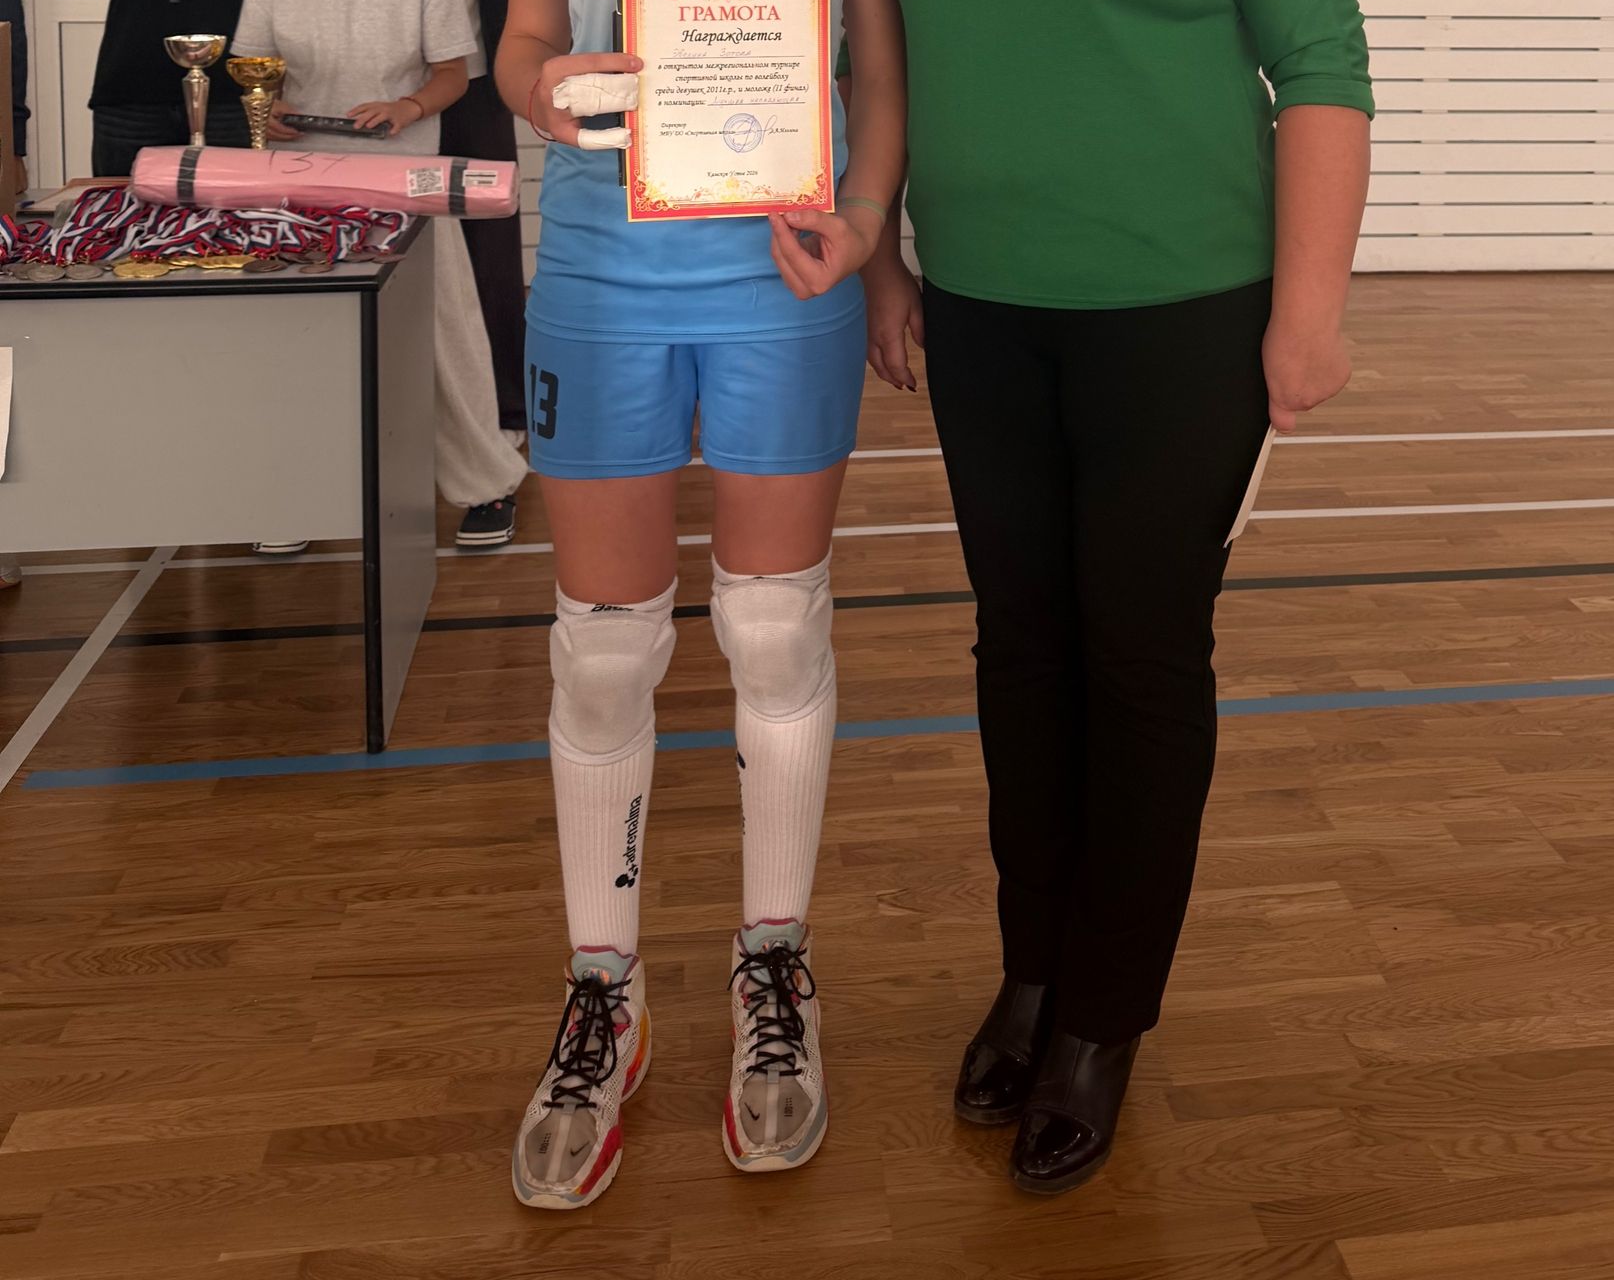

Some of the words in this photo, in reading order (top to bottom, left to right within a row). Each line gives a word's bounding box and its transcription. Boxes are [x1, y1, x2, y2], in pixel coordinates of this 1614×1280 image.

[678, 5, 782, 22] ГРАМОТА
[681, 27, 783, 46] Награждается
[663, 63, 704, 72] открытом
[705, 62, 769, 71] межрегиональном
[770, 62, 801, 70] турнире
[675, 74, 718, 83] спортивной
[754, 72, 789, 82] волейболу
[655, 86, 675, 96] среди
[676, 86, 706, 96] девушек
[744, 86, 772, 94] моложе
[530, 363, 559, 440] 13
